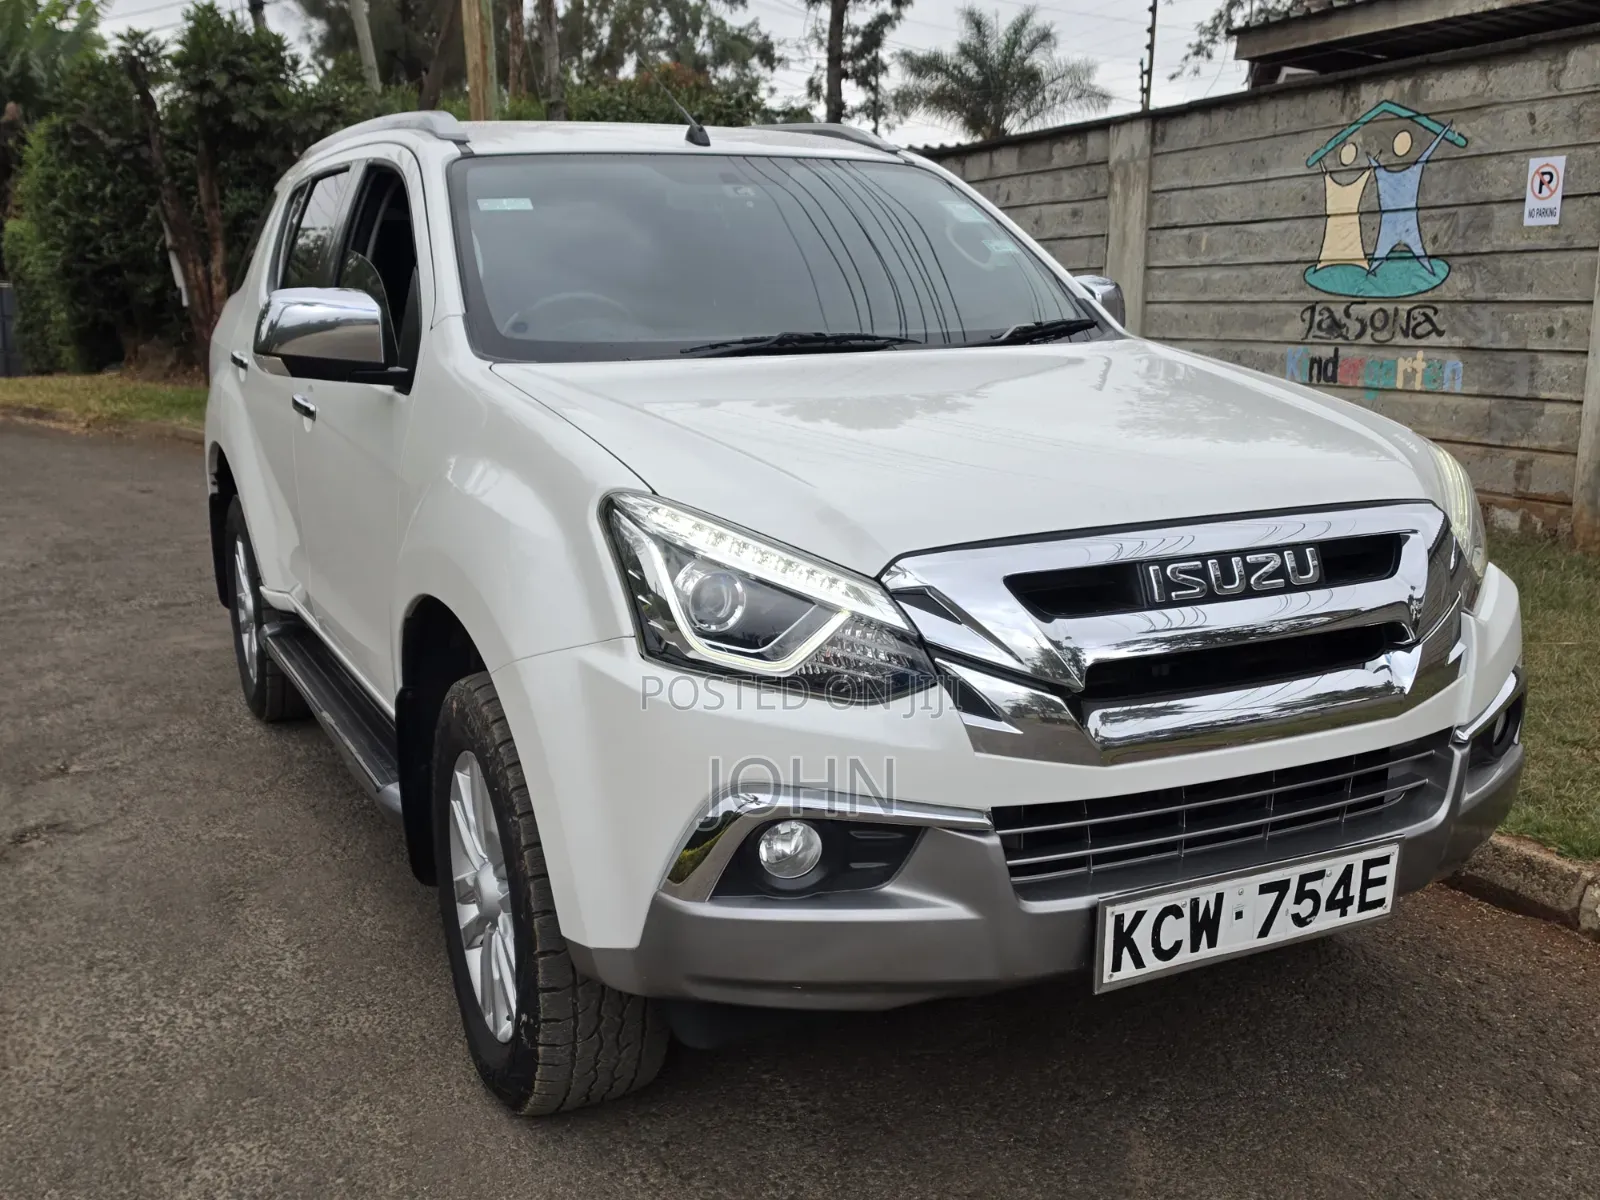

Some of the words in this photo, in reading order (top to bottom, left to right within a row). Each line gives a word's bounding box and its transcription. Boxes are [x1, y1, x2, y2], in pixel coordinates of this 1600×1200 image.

[1538, 171, 1554, 194] P
[1528, 208, 1536, 218] NO
[1536, 206, 1557, 218] PARKING
[1285, 347, 1464, 400] Kindergarten
[1149, 547, 1321, 603] ISUZU
[1110, 892, 1225, 973] KCW
[1256, 854, 1391, 939] 754E
